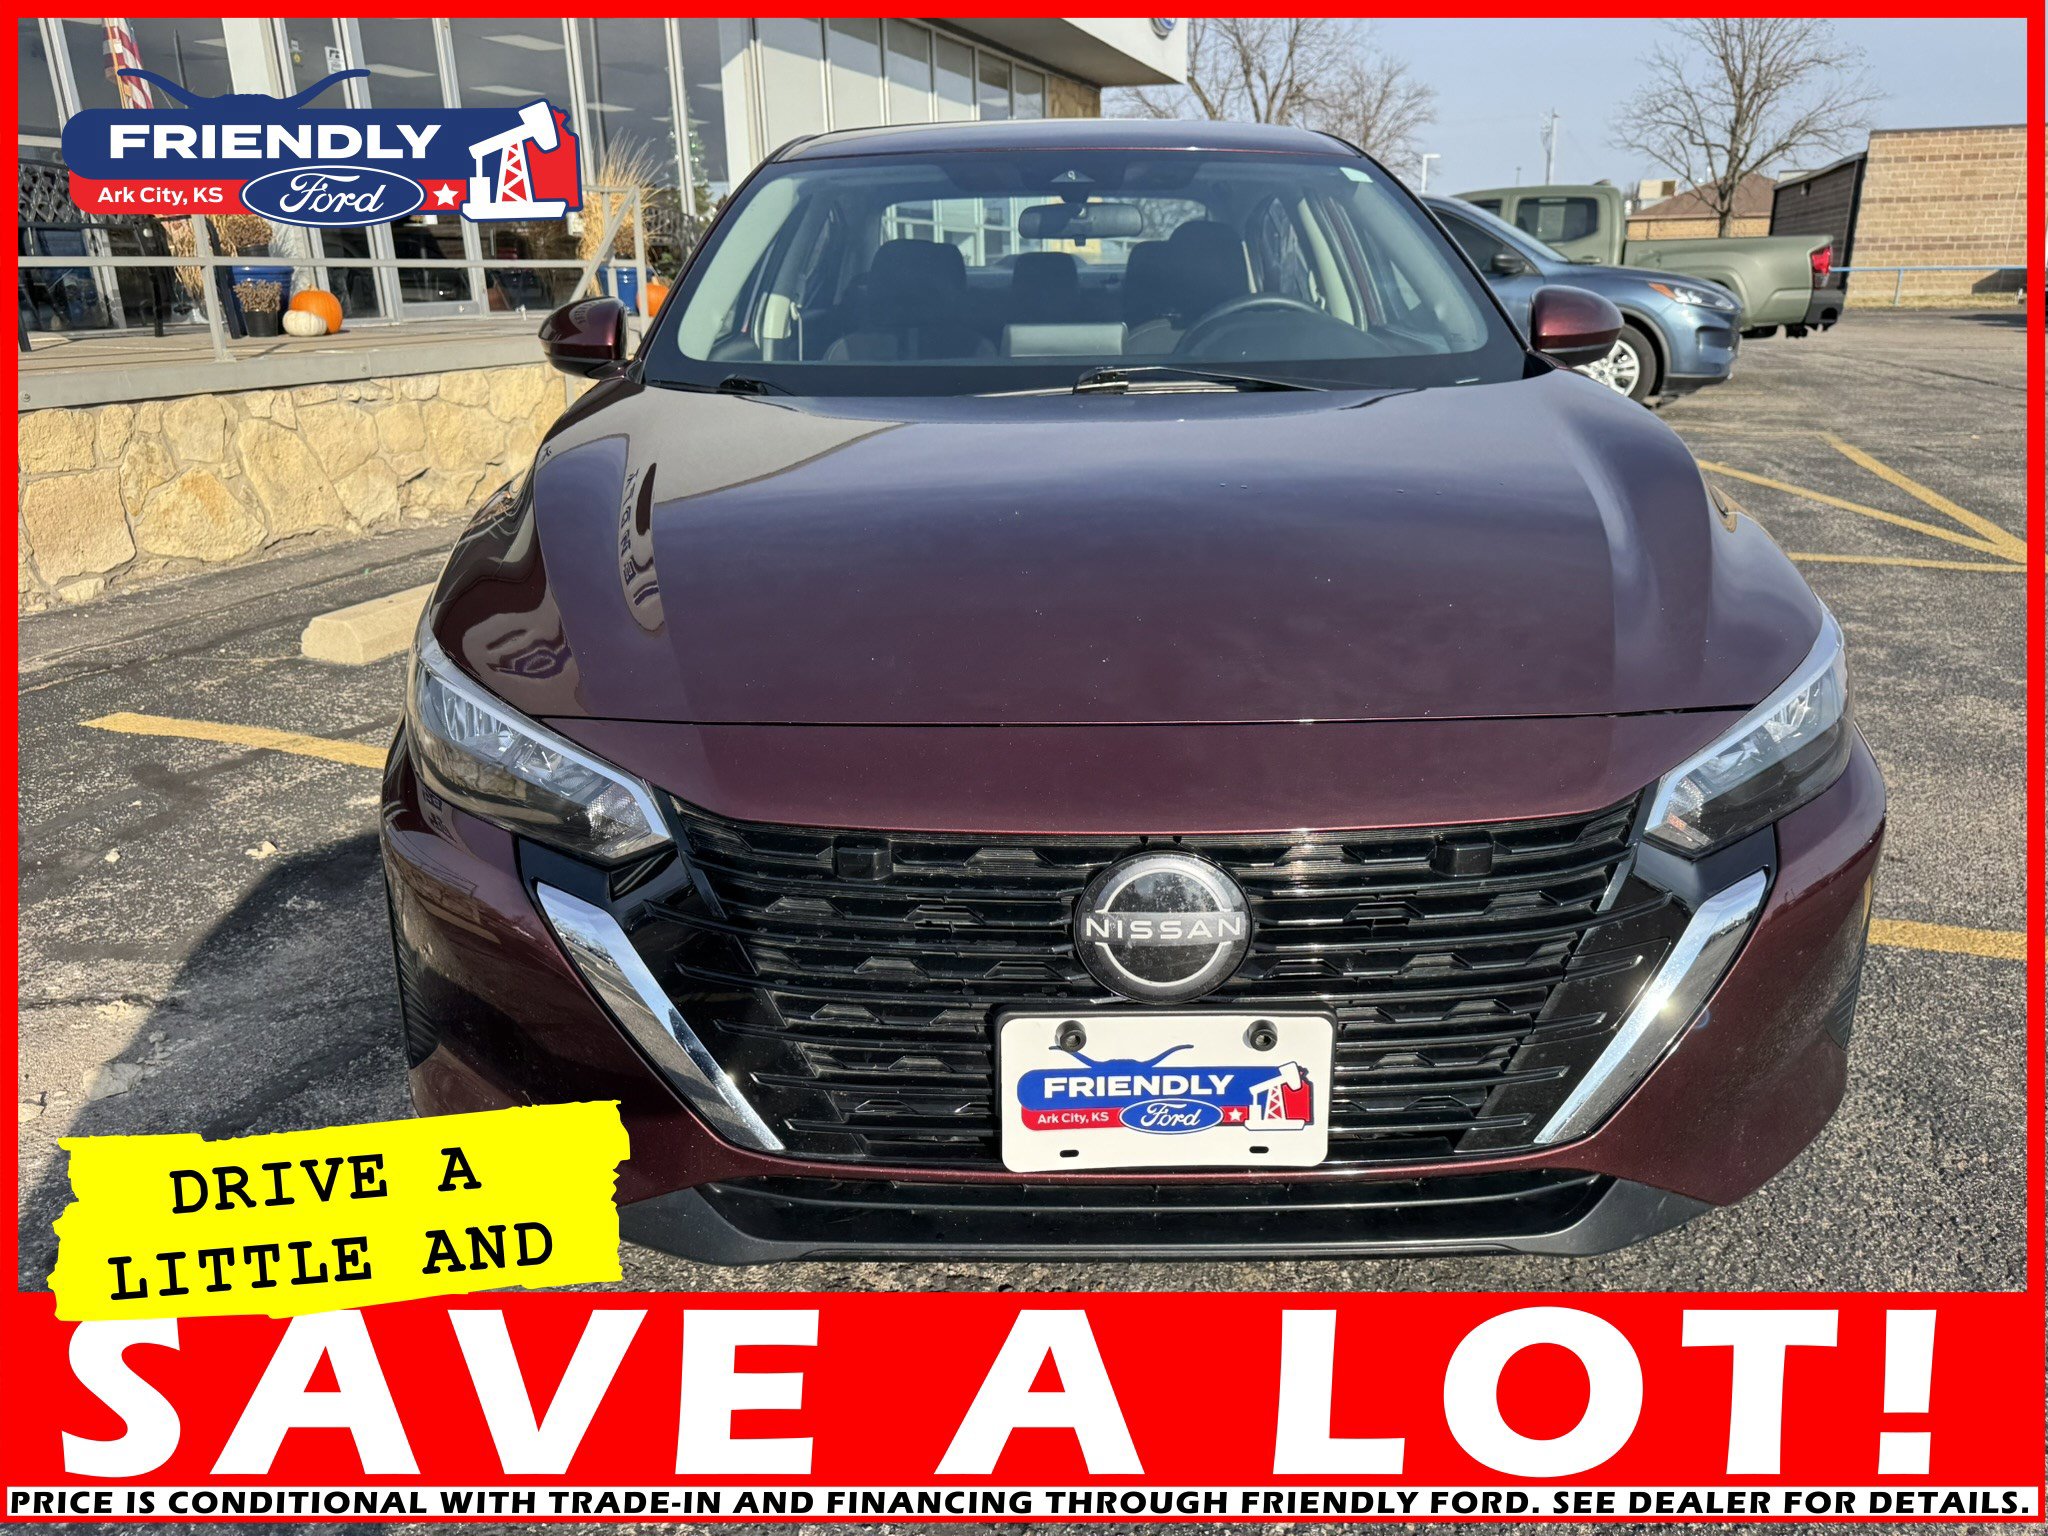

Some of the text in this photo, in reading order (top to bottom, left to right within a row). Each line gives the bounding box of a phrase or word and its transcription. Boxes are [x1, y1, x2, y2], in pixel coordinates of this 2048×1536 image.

[1085, 917, 1243, 940] NISSAN
[1043, 1074, 1235, 1099] FRIENDLY
[1037, 1110, 1110, 1125] Ark City, KS
[1139, 1102, 1202, 1129] Ford
